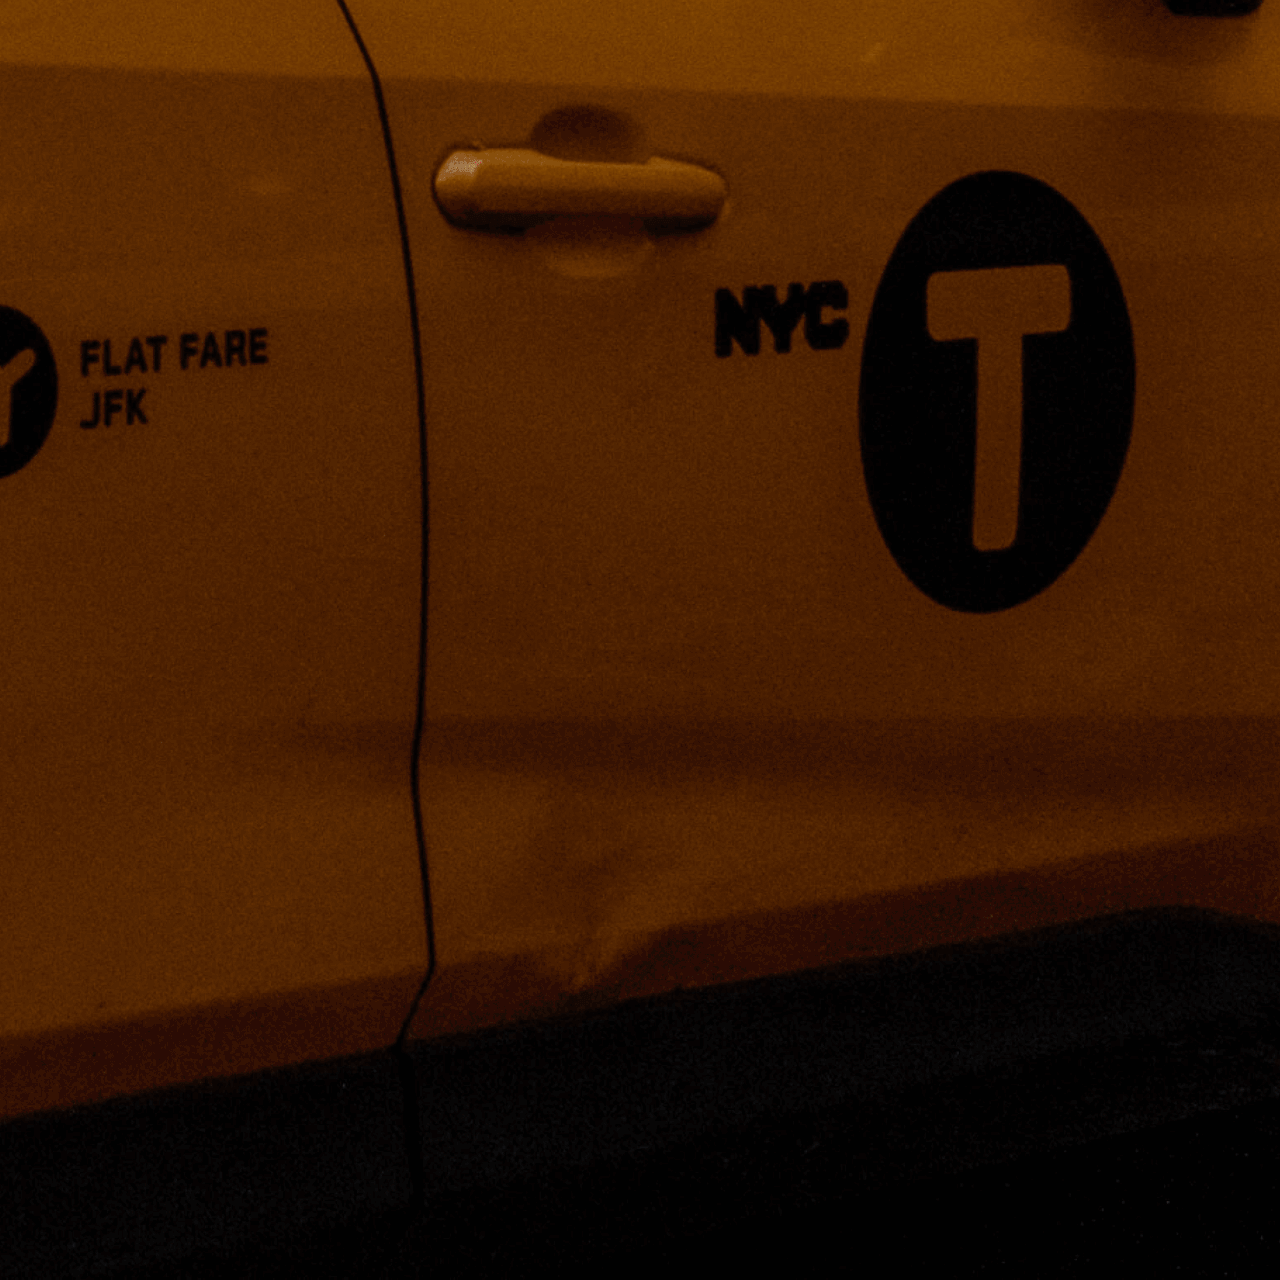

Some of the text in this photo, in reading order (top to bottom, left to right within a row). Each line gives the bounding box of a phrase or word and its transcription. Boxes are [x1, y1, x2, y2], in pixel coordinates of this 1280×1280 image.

[79, 327, 269, 377] FLAT FARE
[79, 388, 148, 429] JFK
[714, 263, 1073, 553] NYC T
